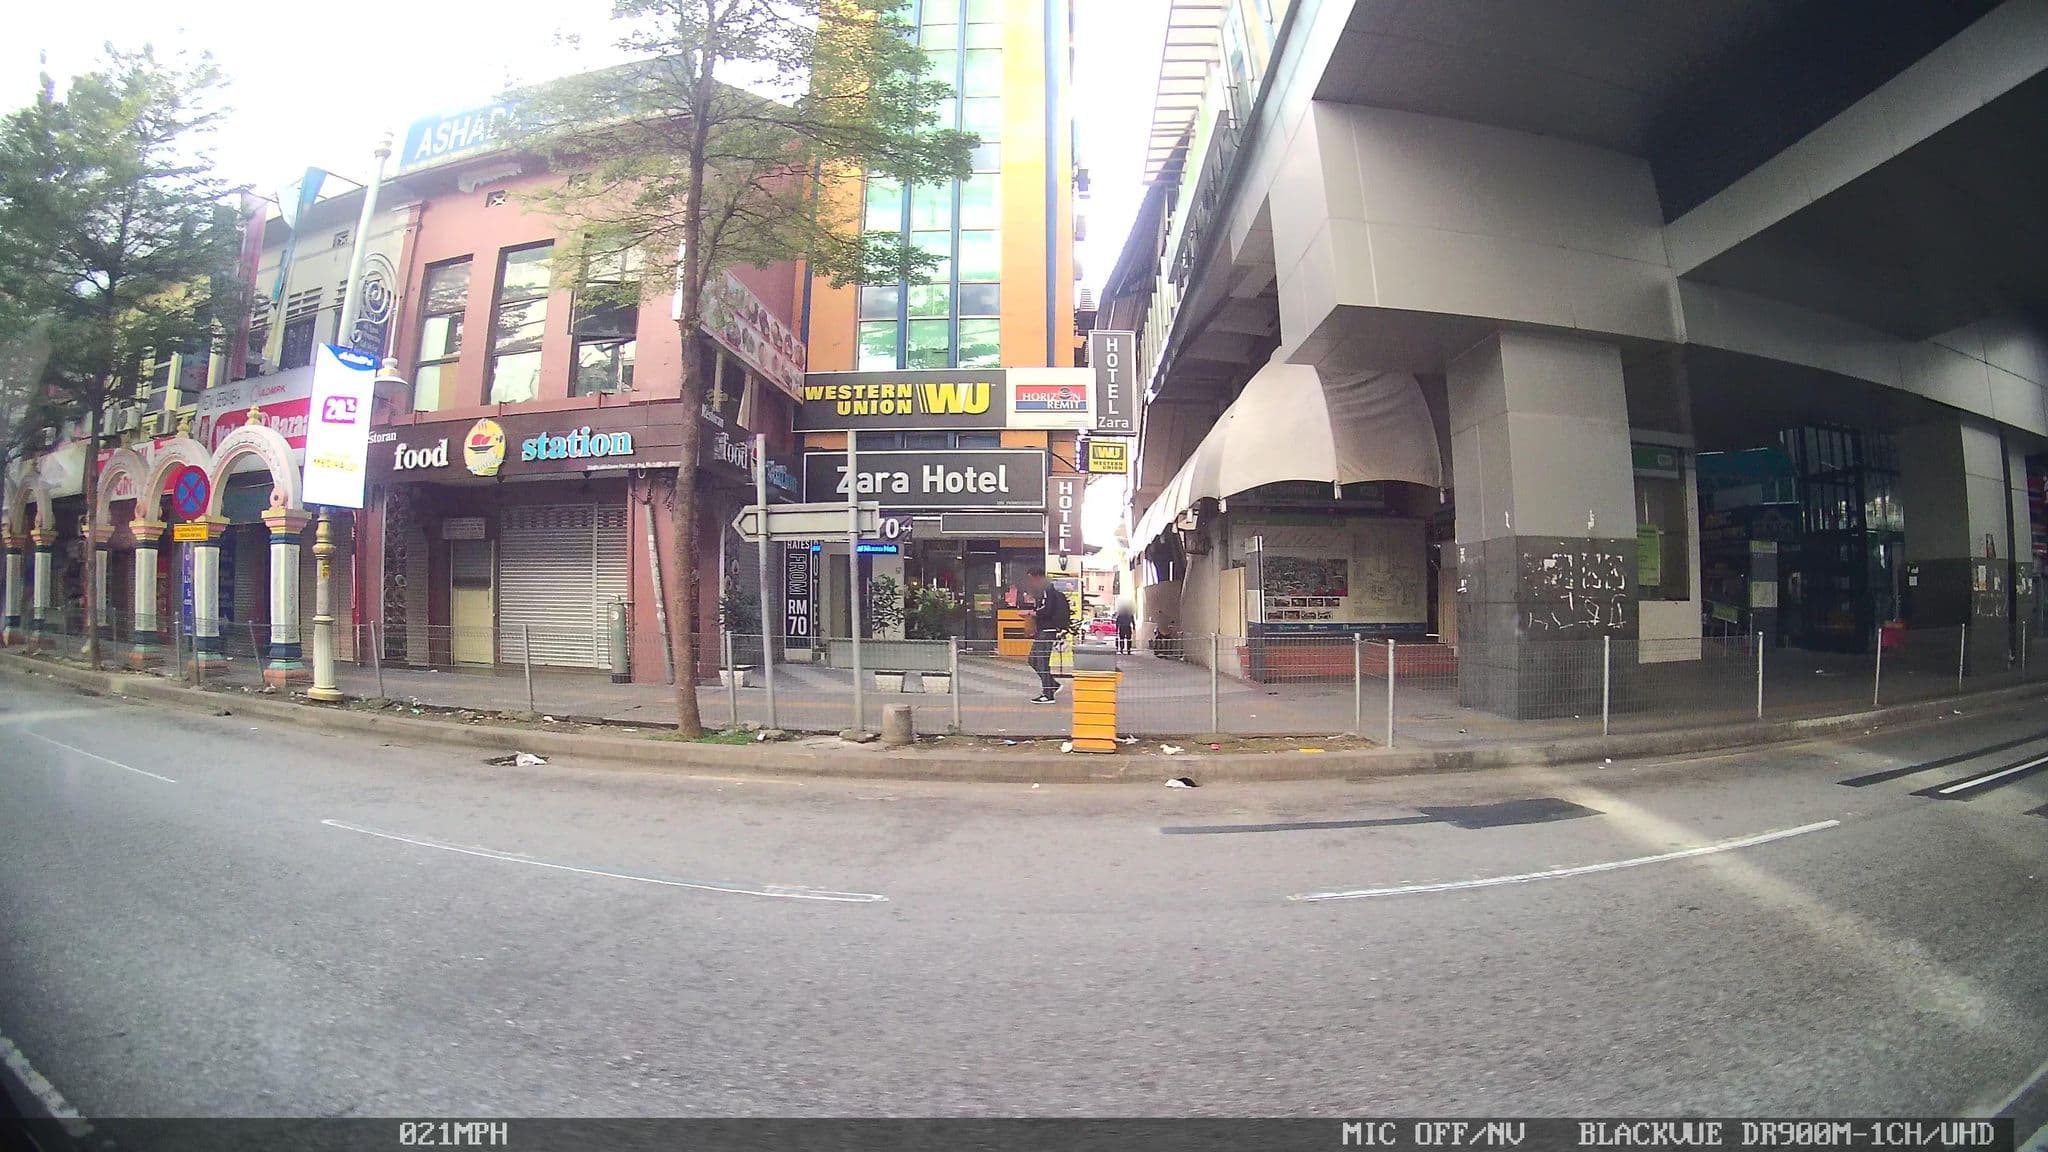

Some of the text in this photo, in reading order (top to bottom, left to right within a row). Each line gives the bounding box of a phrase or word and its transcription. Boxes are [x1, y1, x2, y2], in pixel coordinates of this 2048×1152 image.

[1106, 337, 1119, 414] HOTEL
[805, 384, 913, 401] WESTERN
[916, 382, 993, 414] WU
[1022, 388, 1081, 402] HORIZON
[837, 399, 913, 416] UNION
[1047, 400, 1080, 410] REMIT
[1098, 416, 1129, 428] Zara
[368, 430, 397, 443] storan
[521, 426, 634, 461] station
[393, 438, 449, 470] food
[1094, 447, 1122, 459] WU
[836, 464, 1009, 494] Zara Hotel
[1058, 481, 1073, 552] HOTEL
[788, 553, 808, 596] FROM
[788, 600, 808, 615] RM
[788, 616, 808, 636] 70
